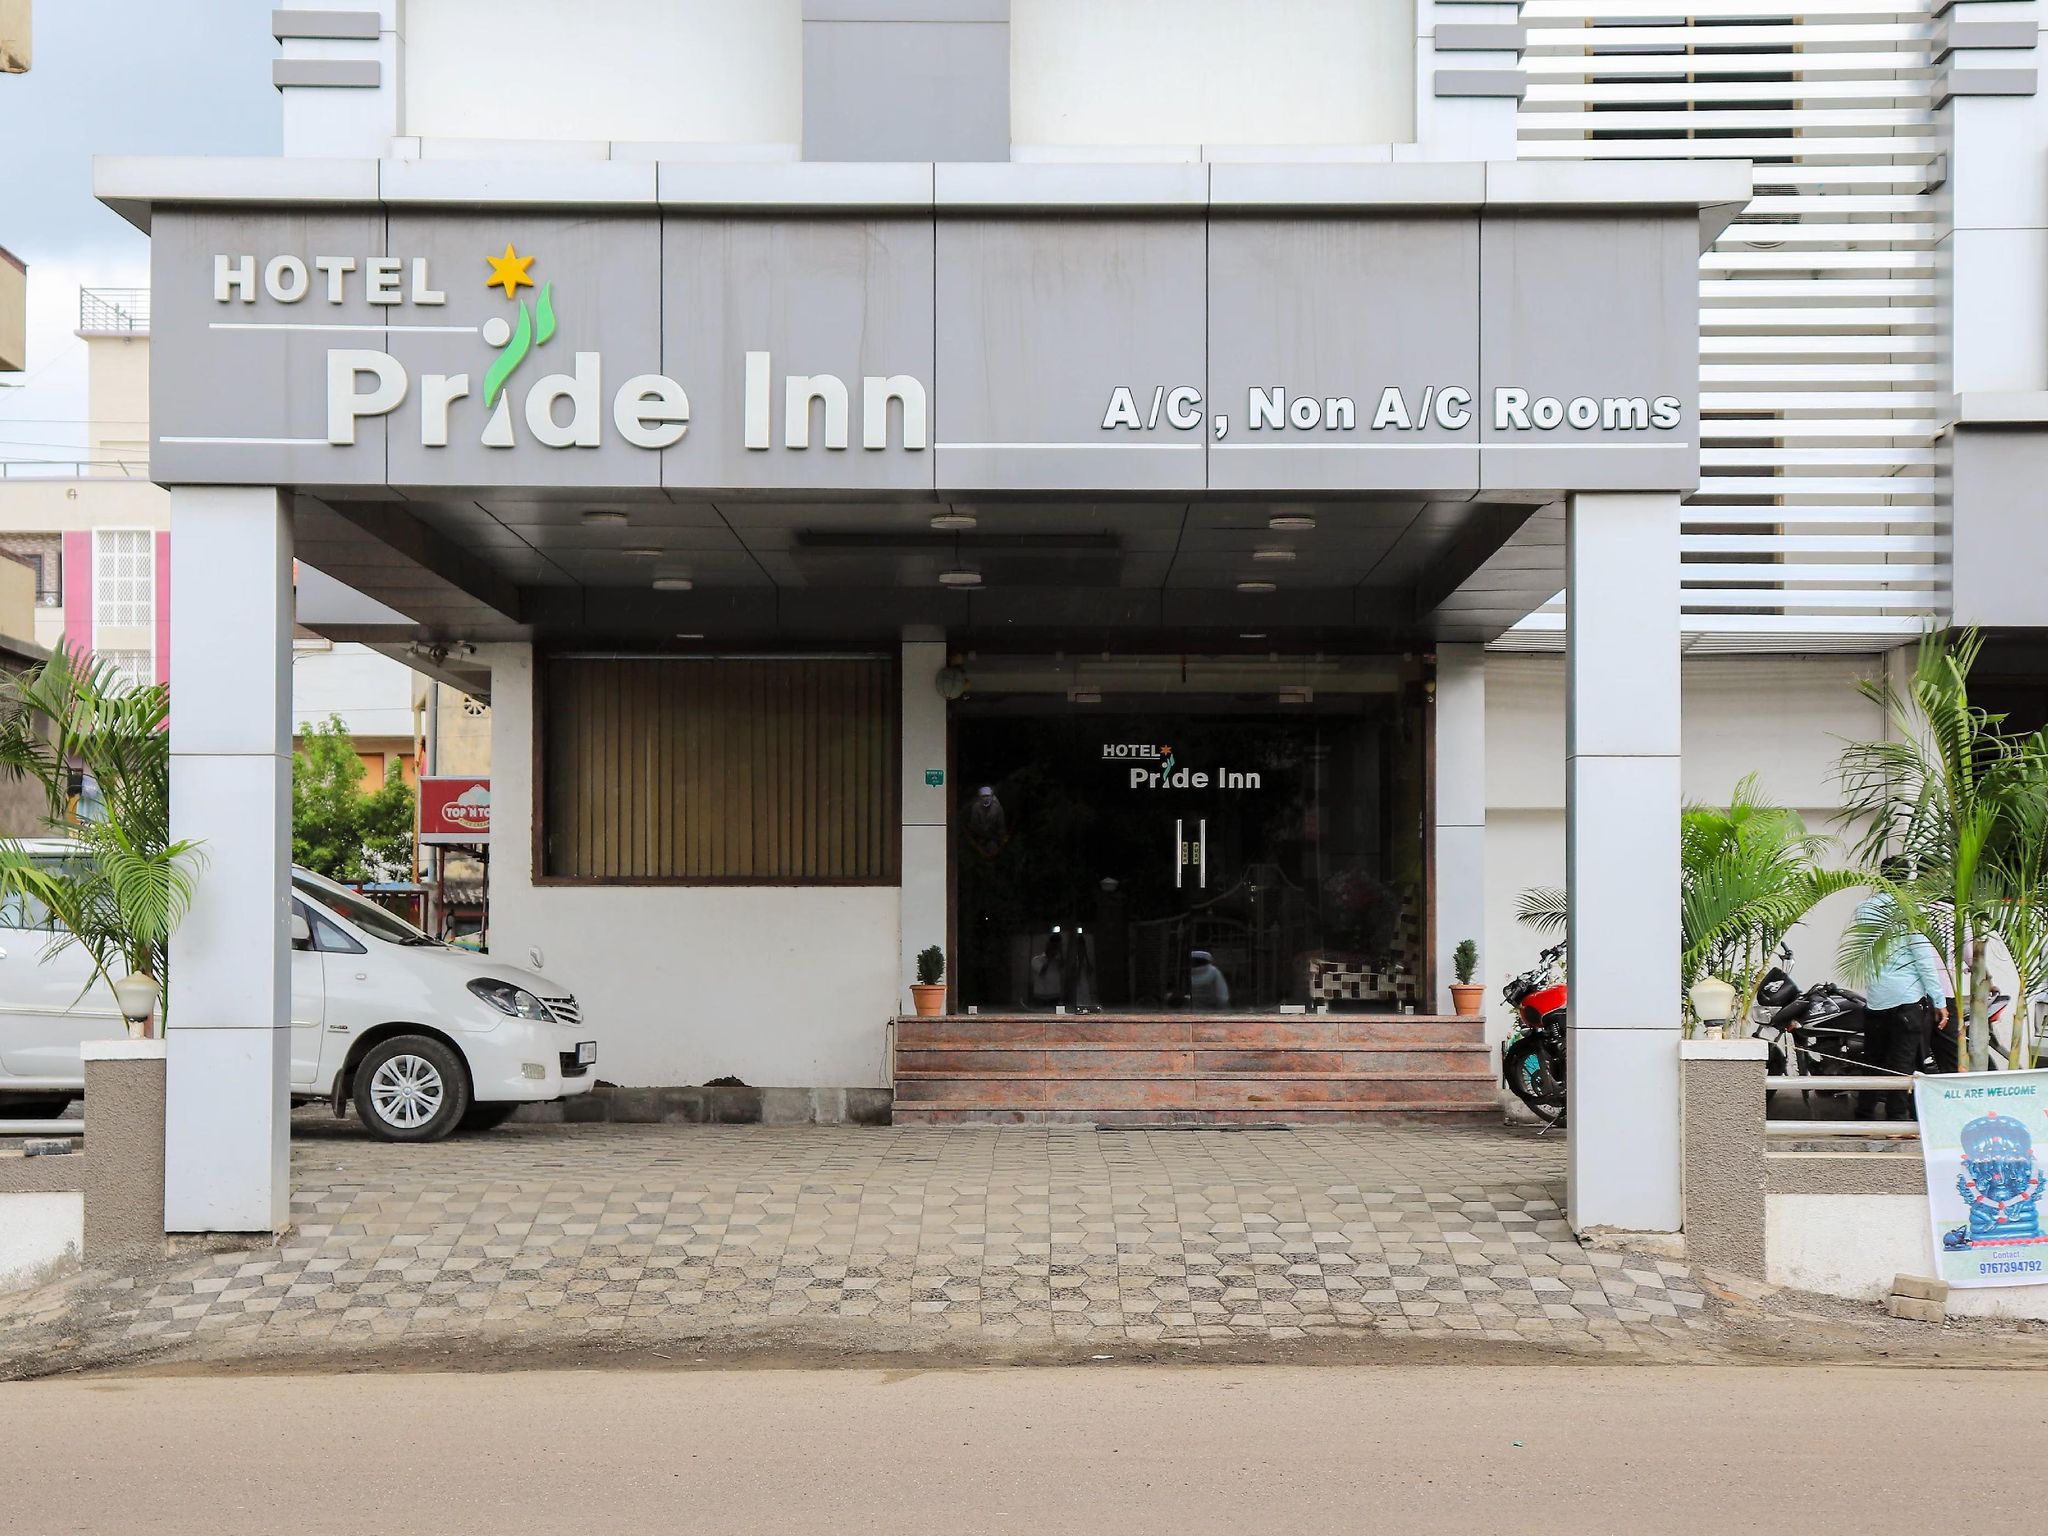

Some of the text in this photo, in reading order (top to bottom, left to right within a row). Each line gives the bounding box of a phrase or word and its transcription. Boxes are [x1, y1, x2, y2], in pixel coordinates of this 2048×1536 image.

[212, 253, 446, 306] HOTEL
[326, 348, 928, 450] Pride Inn
[1248, 386, 1356, 431] Non
[1371, 386, 1472, 431] A/C
[1494, 386, 1681, 431] Rooms
[1103, 744, 1161, 757] HOTEL
[1130, 767, 1261, 789] Pride Inn
[446, 807, 467, 818] TOP
[1944, 1085, 2037, 1099] ALL ARE WELCOME
[1979, 1260, 2042, 1274] 9767394792
